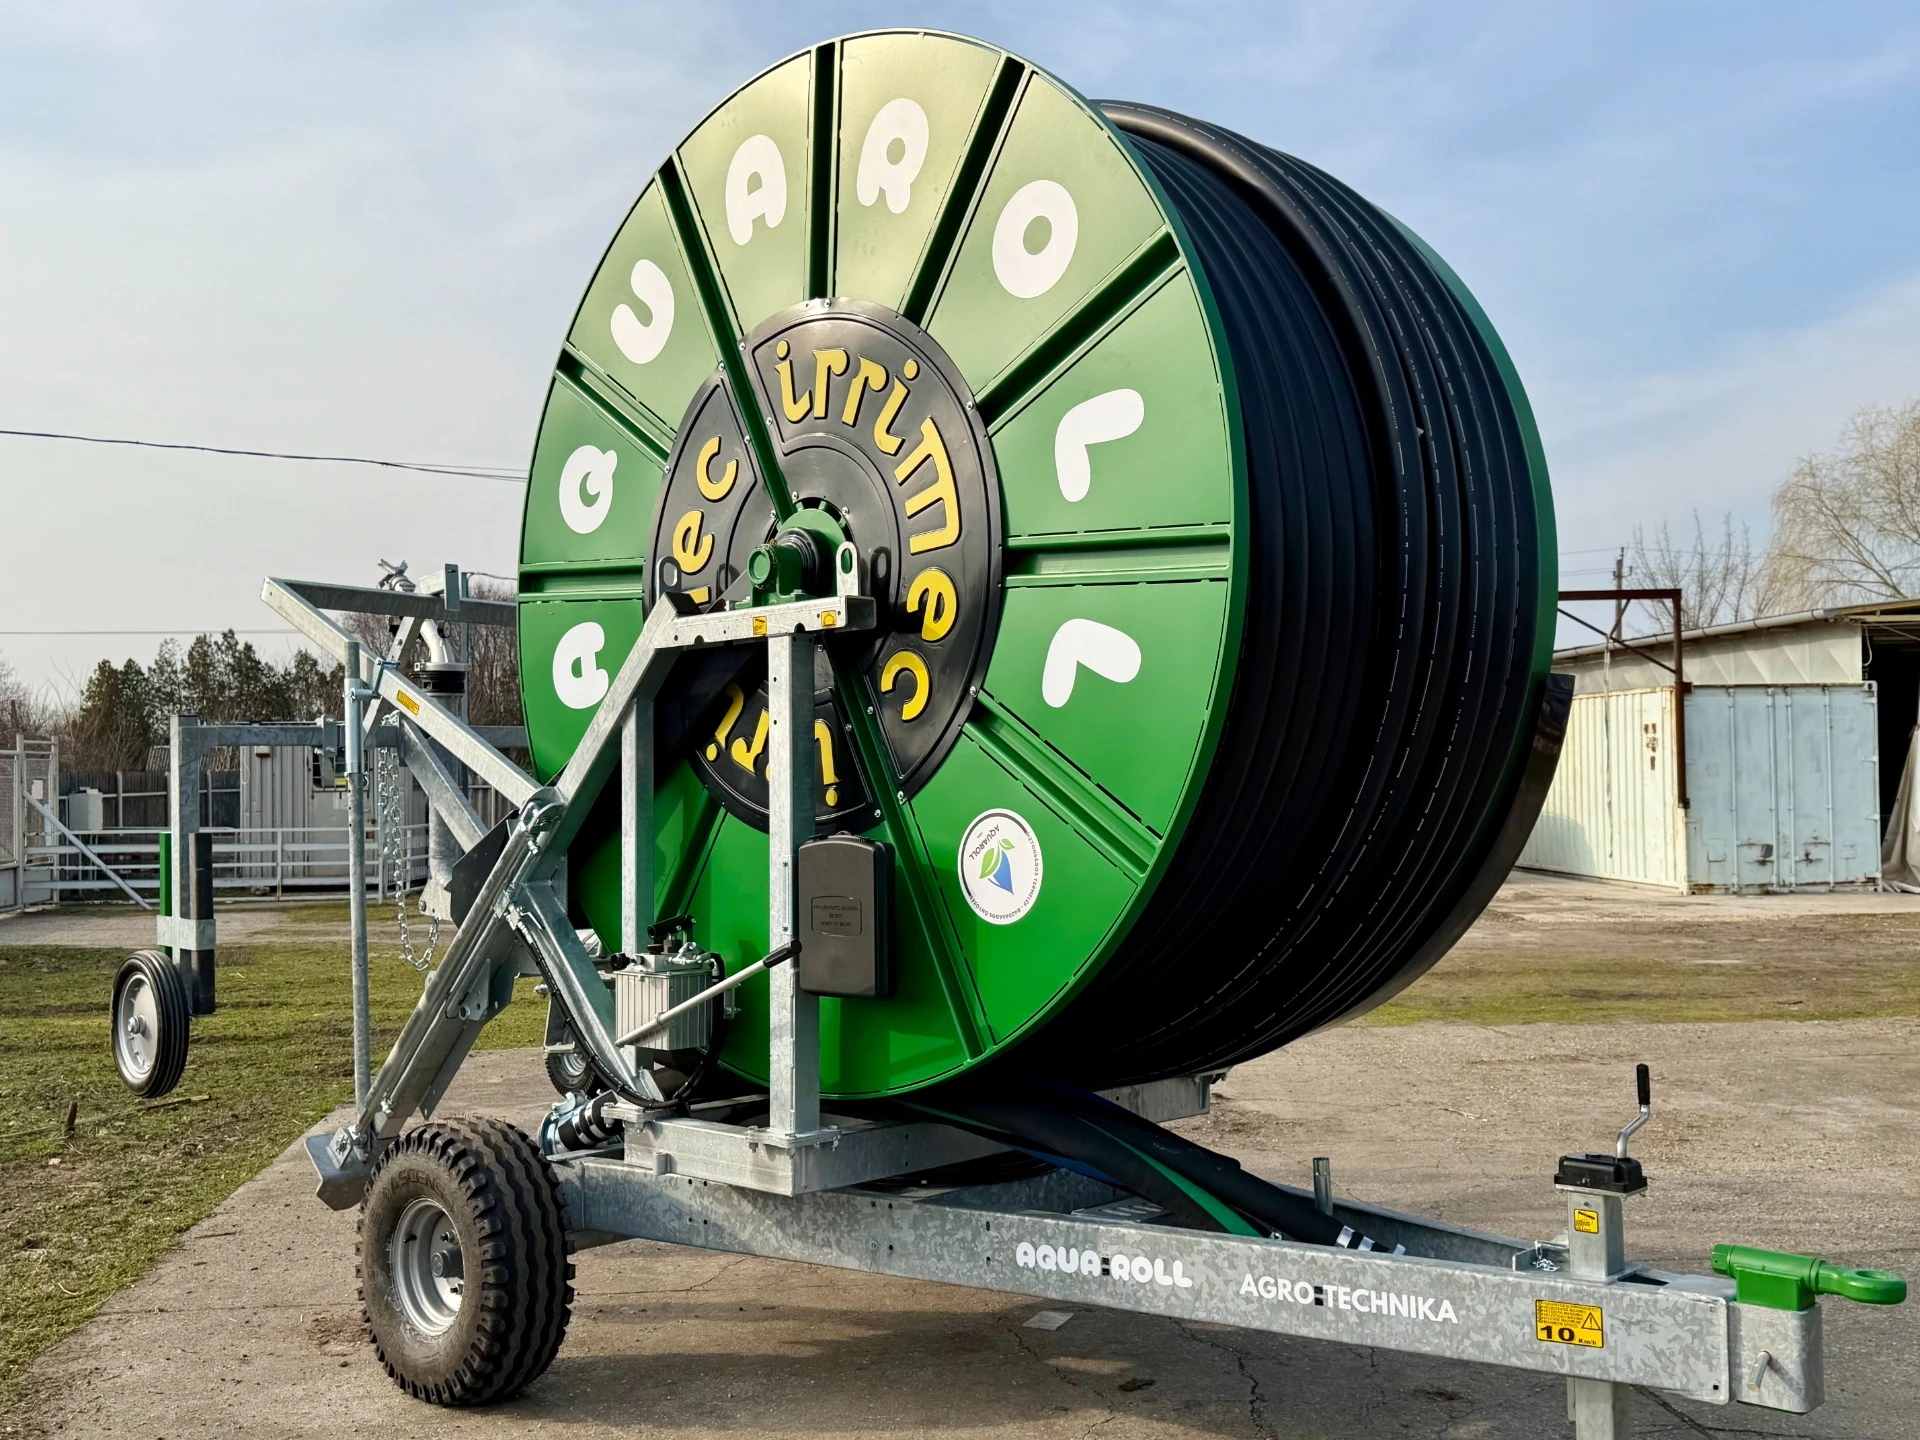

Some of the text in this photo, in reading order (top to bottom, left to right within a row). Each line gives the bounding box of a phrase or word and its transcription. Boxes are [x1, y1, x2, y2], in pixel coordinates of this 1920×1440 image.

[553, 98, 1145, 709] AQUAROLL
[969, 824, 1000, 860] AQUAROLL
[1541, 1325, 1575, 1342] 10
